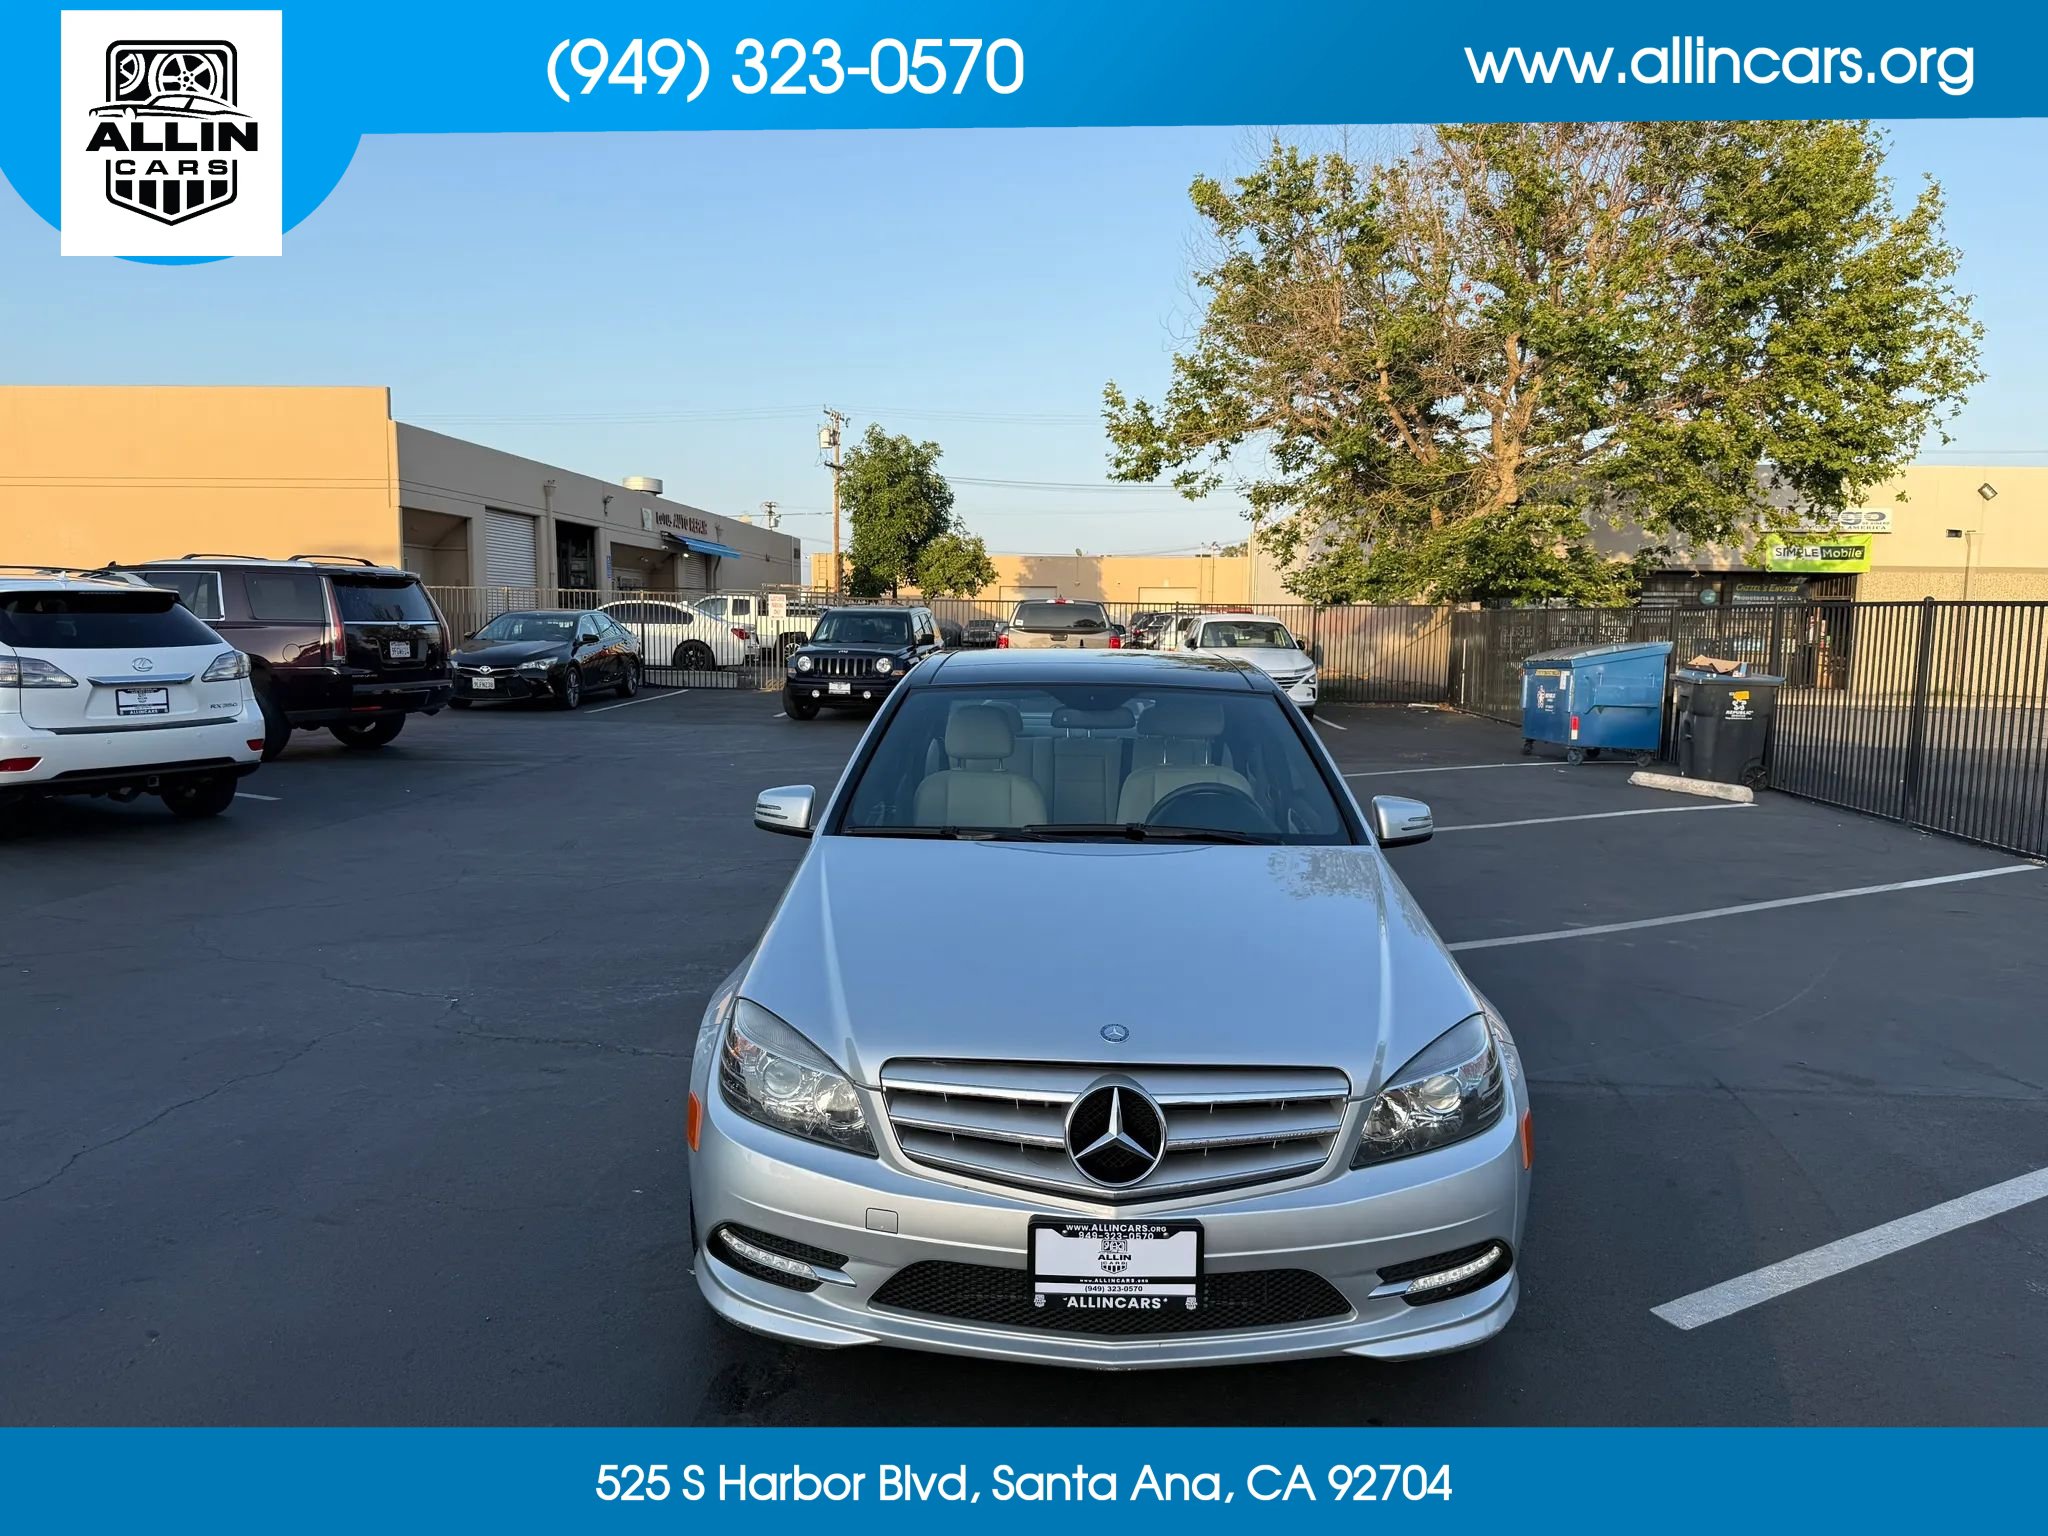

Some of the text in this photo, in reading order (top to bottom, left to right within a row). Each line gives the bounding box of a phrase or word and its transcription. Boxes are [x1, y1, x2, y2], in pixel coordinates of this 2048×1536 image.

[1822, 548, 1862, 558] Mobile
[1078, 1231, 1154, 1240] 949-323-0570
[1084, 1285, 1105, 1293] (949)
